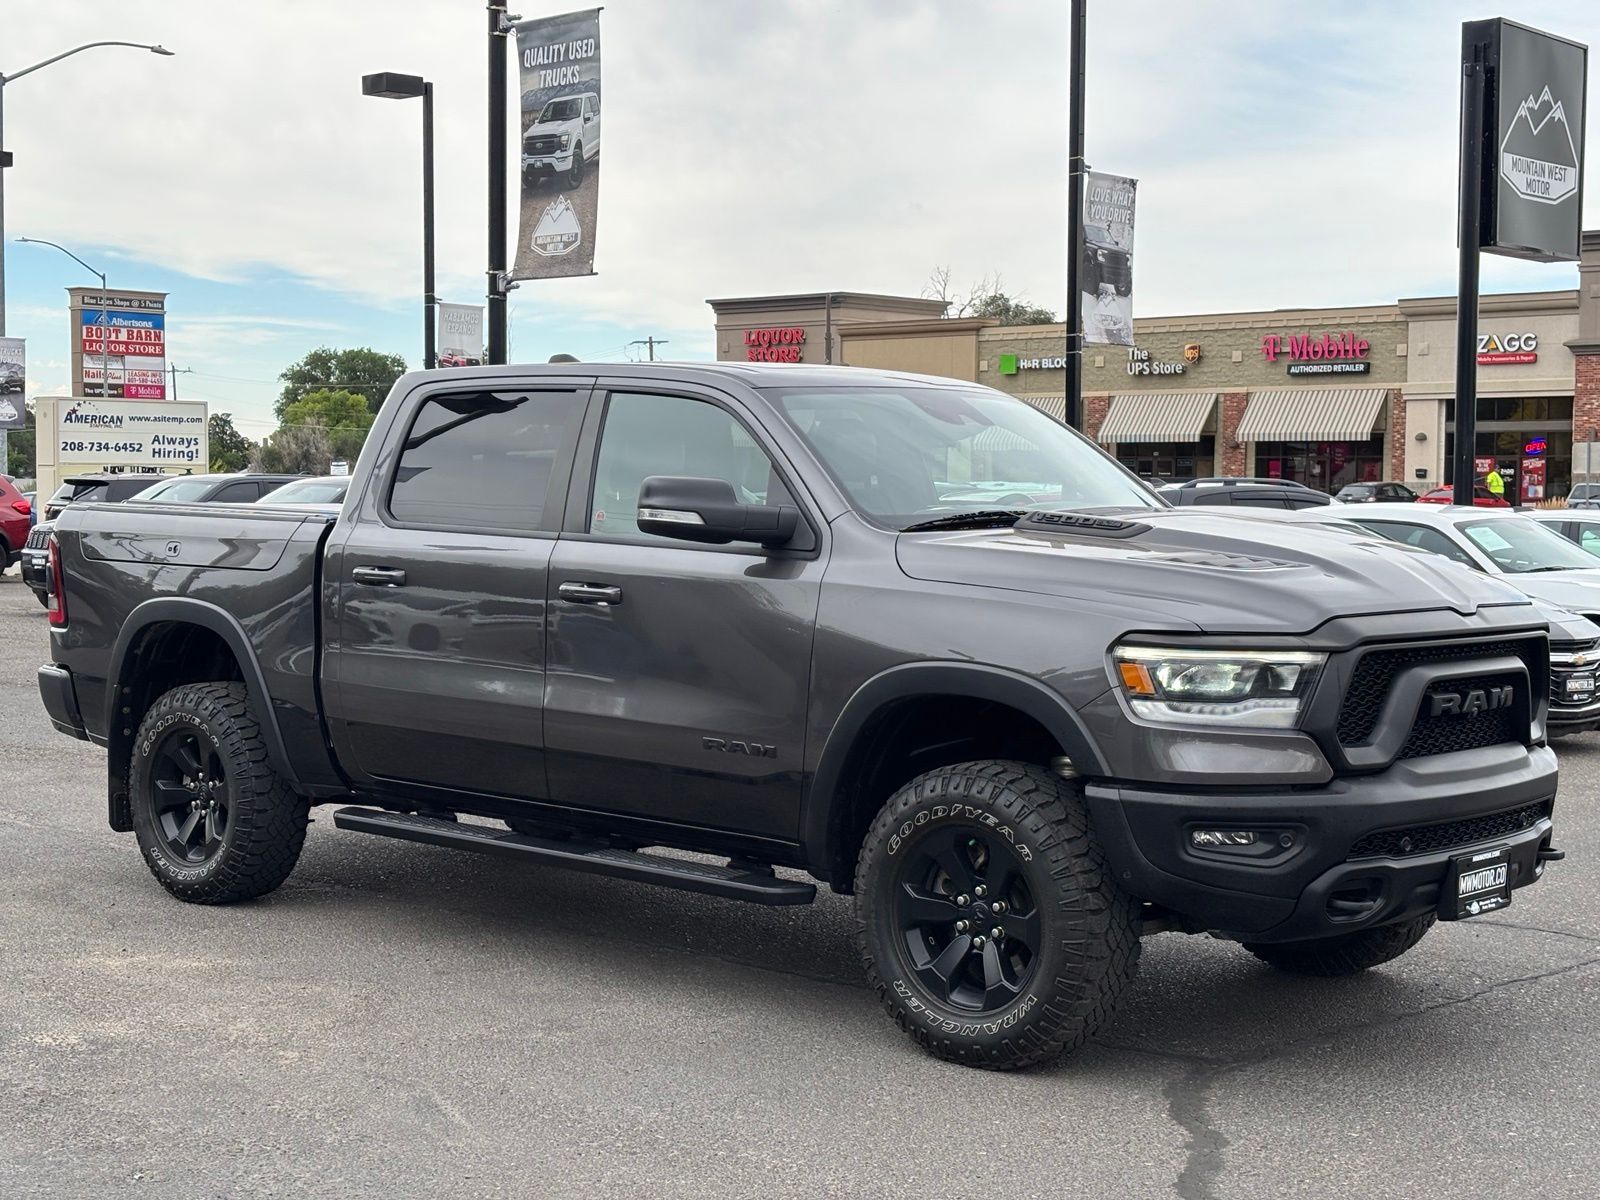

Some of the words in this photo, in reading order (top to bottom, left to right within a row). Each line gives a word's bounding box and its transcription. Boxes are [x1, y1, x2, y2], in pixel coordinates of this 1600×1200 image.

[524, 43, 566, 68] QUALITY
[568, 38, 594, 60] USED
[540, 66, 580, 88] TRUCKS
[1512, 156, 1546, 178] MOUNTAIN
[1547, 164, 1567, 182] WEST
[1525, 176, 1550, 196] MOTOR
[1090, 188, 1110, 203] LOVE
[1112, 190, 1133, 206] WHAT
[1090, 204, 1108, 220] YOU
[1108, 206, 1132, 224] DRIVE
[114, 298, 130, 307] Shops
[111, 317, 152, 328] Albertsons
[86, 326, 121, 340] BOOT
[126, 330, 161, 342] BARN
[744, 328, 804, 346] LIQUOR
[128, 344, 162, 354] STORE
[1478, 333, 1537, 352] ZAGG
[748, 346, 800, 362] STORE
[1128, 348, 1148, 360] The
[1020, 359, 1039, 368] H&R
[1042, 358, 1066, 368] BLOC
[1127, 362, 1150, 375] UPS
[1152, 362, 1183, 374] Store
[1290, 364, 1332, 373] AUTHORIZED
[1333, 364, 1364, 372] RETAILER
[64, 411, 124, 424] AMERICAN
[128, 415, 202, 424] www.asitemp.com
[62, 441, 143, 452] 208-734-6452
[152, 434, 199, 448] Always
[1526, 442, 1546, 452] OPEN
[152, 448, 199, 461] Hiring!
[1036, 512, 1095, 526] 1500
[1430, 686, 1514, 716] RAM
[702, 736, 777, 759] RAM
[888, 803, 1033, 862] GOODYEAR
[151, 842, 226, 880] WRANGLER
[1460, 866, 1506, 894] MWMOTOR.CO
[893, 980, 1039, 1036] WRANGLER
